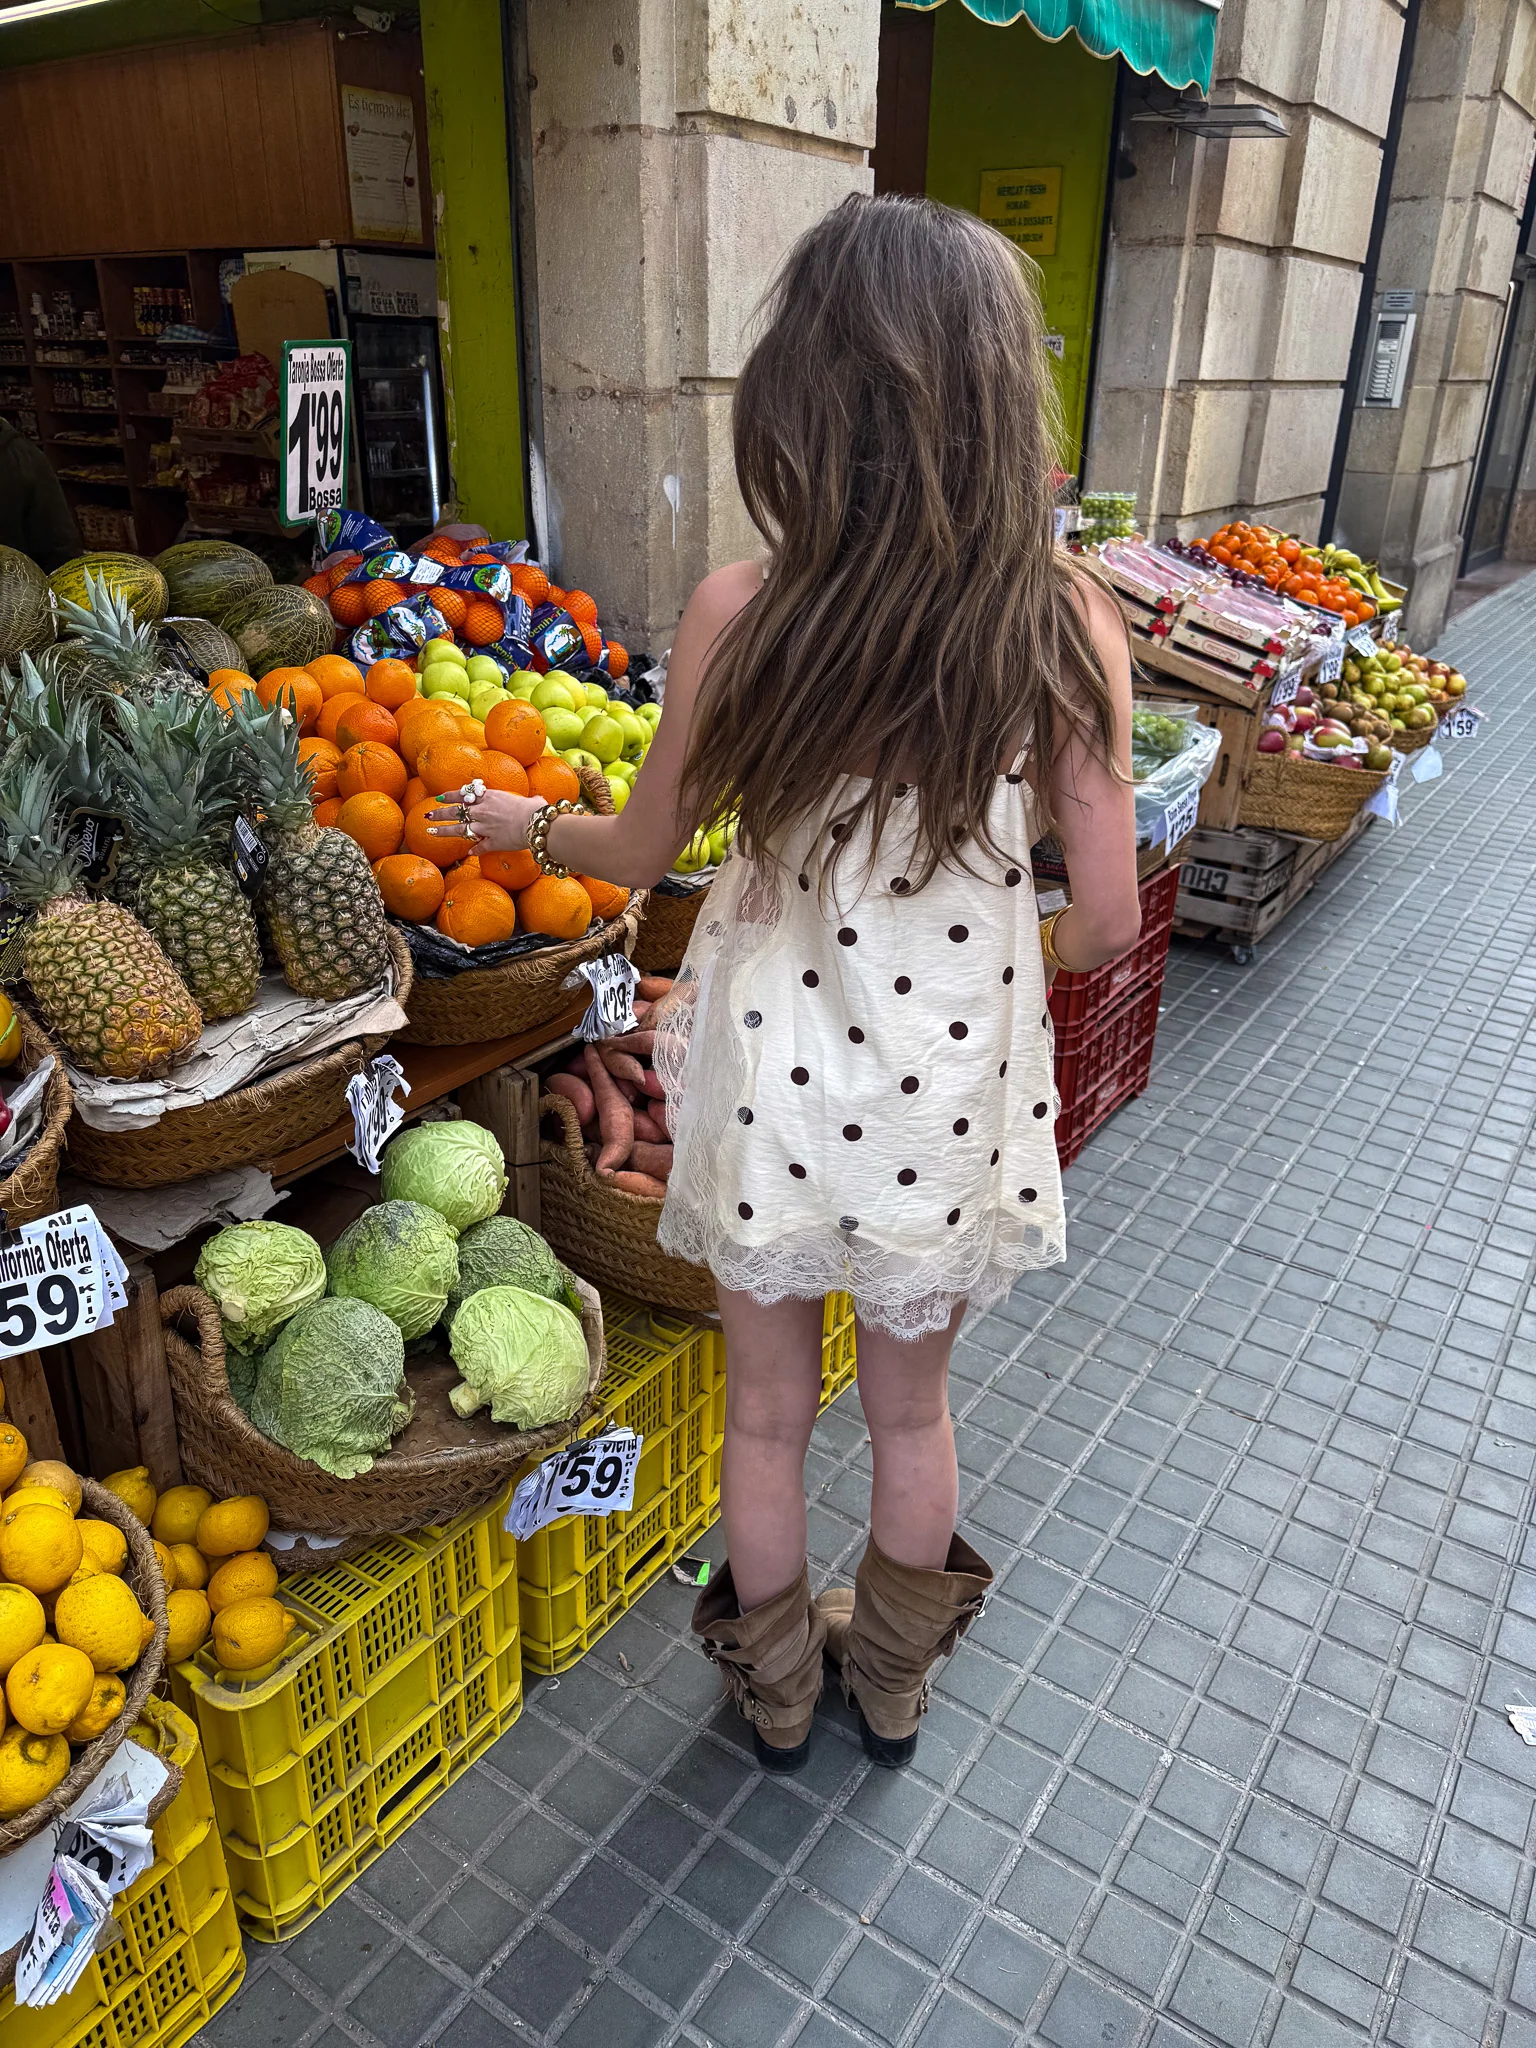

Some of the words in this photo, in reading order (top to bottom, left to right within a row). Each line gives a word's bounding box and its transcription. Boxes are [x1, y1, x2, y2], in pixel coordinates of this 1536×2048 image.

[347, 93, 360, 110] Es
[361, 97, 394, 118] tiempo
[1025, 183, 1047, 195] FRESH
[288, 354, 310, 391] Taronja
[310, 353, 326, 384] Bossa
[326, 351, 344, 382] Oferta
[288, 390, 343, 513] 1'99
[309, 486, 342, 511] Bossa
[1446, 718, 1474, 737] 1'59
[76, 817, 95, 868] Orsero
[602, 982, 627, 1023] 1'29
[0, 1236, 46, 1284] ifornia
[45, 1227, 92, 1270] Oferta
[78, 1282, 97, 1325] Kilo
